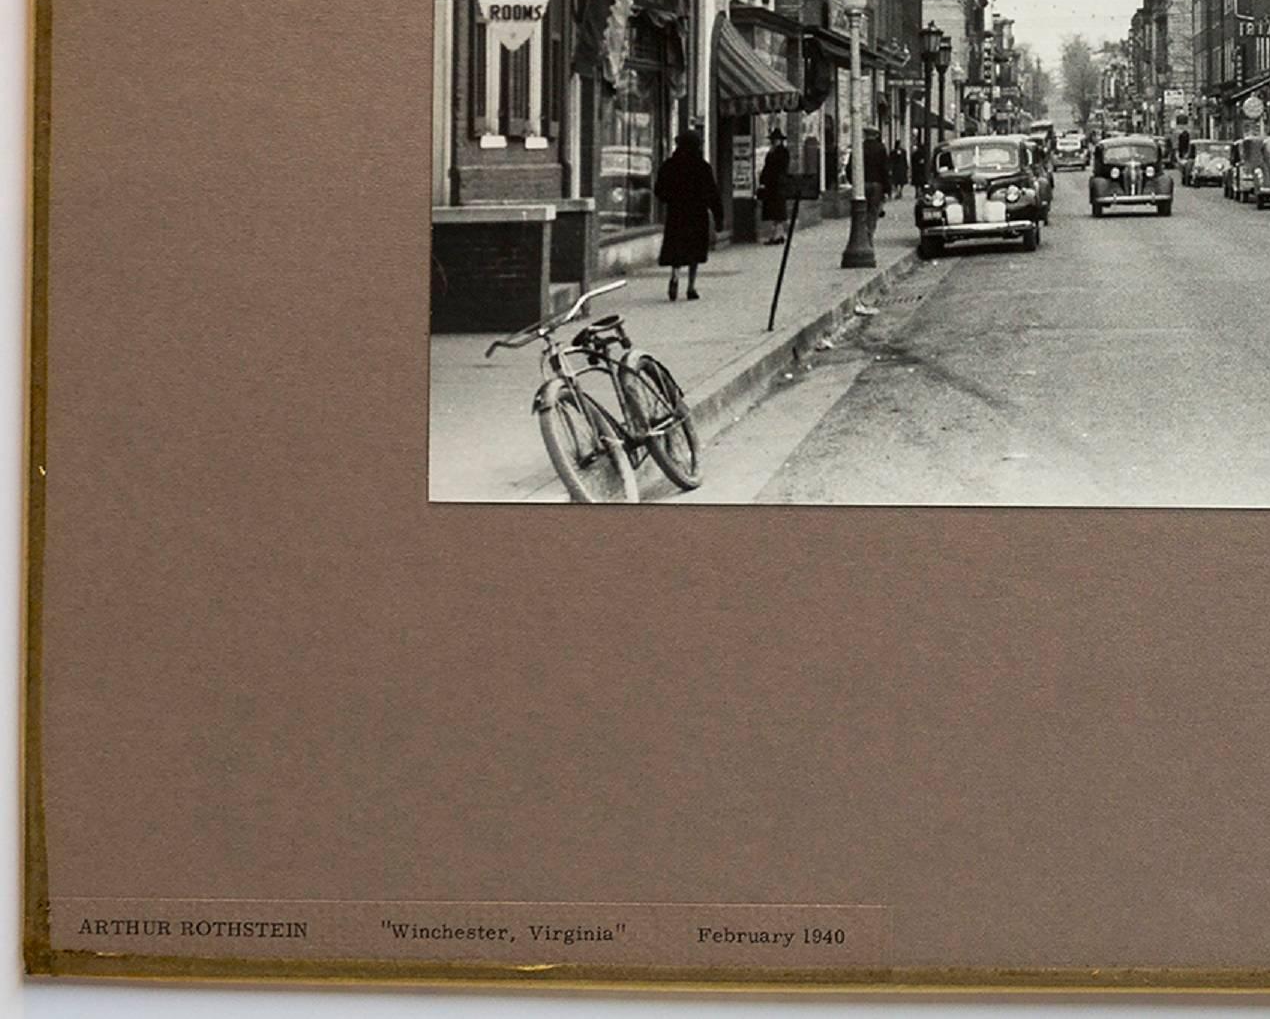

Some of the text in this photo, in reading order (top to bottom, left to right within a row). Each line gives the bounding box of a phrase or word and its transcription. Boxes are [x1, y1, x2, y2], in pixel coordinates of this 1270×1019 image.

[489, 3, 543, 21] ROOMS
[78, 919, 846, 948] ARTHUR ROTHSTEIN "Winchester, Virginia" February 1940
